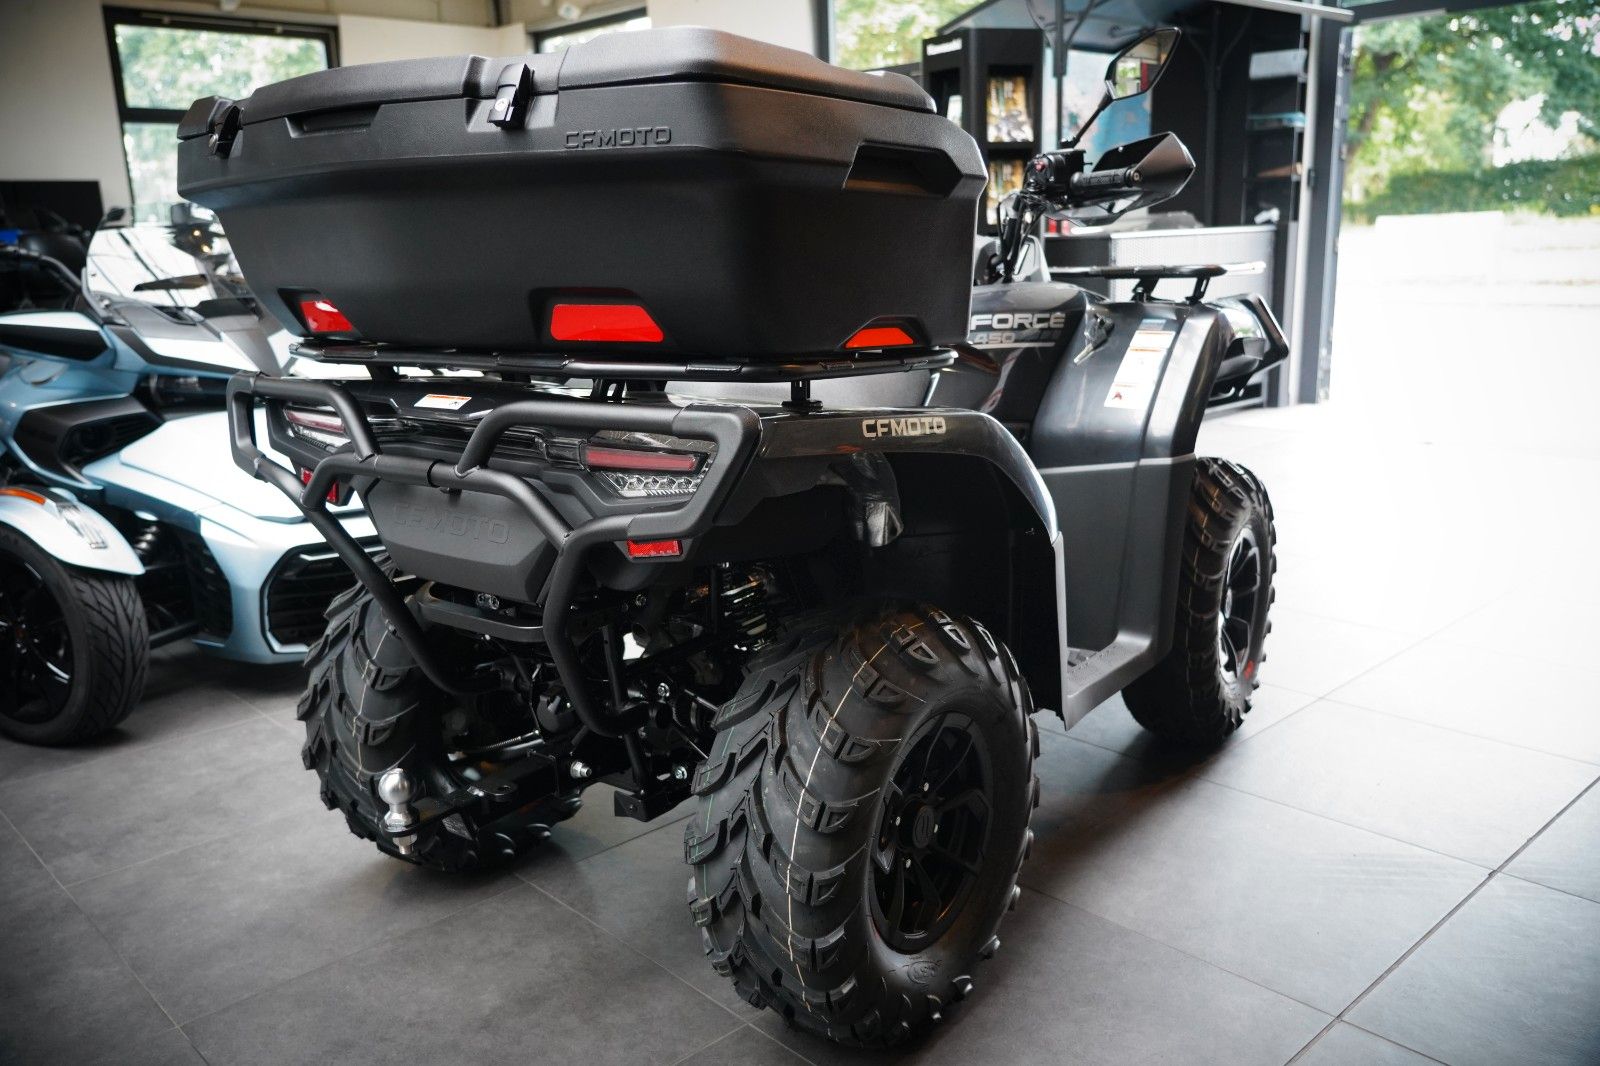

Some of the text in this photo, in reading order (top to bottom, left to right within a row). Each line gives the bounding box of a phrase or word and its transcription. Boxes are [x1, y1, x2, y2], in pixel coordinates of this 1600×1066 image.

[565, 126, 672, 149] CFMOTO
[970, 312, 1066, 331] FORCE
[862, 416, 947, 438] CFMOTO
